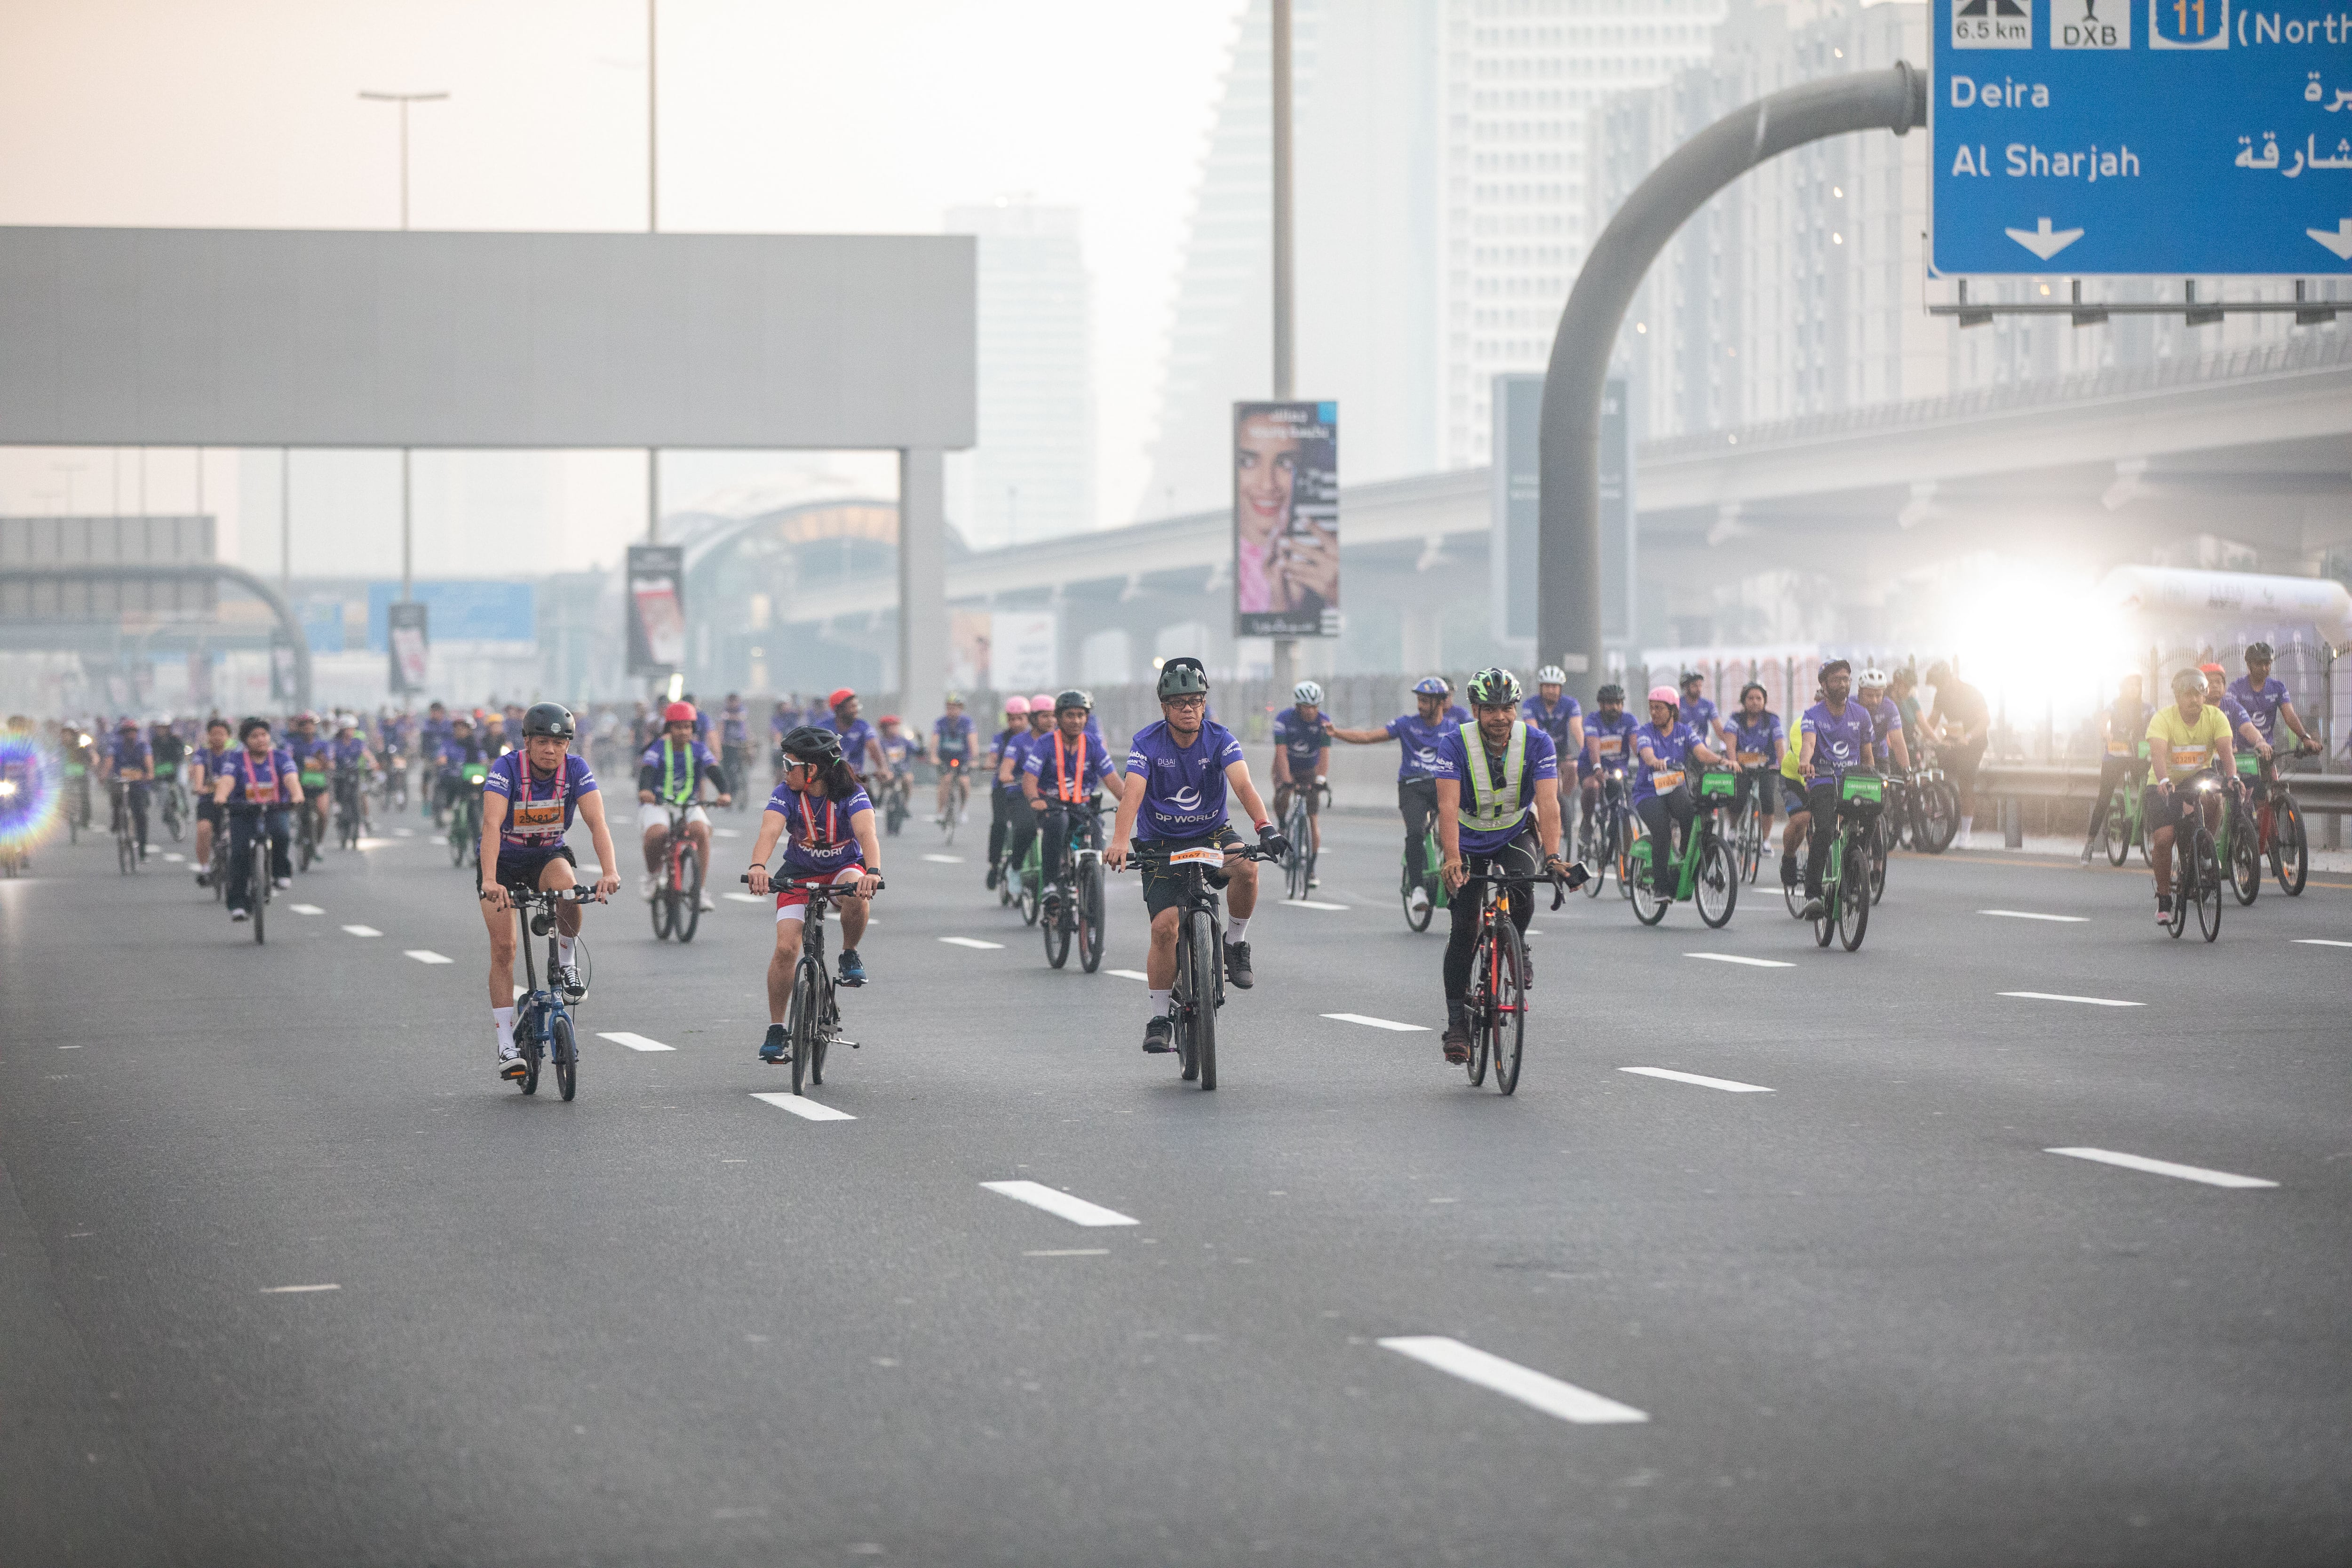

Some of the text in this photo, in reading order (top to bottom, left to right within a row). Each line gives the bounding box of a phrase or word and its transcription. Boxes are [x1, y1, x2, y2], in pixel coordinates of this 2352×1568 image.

[1956, 20, 2026, 40] 6.5 km
[2173, 0, 2204, 35] 11
[2064, 25, 2116, 46] DXB
[1951, 75, 2049, 108] Deira
[1952, 143, 2140, 183] Al Sharjah
[1156, 810, 1219, 823] DP WORLD
